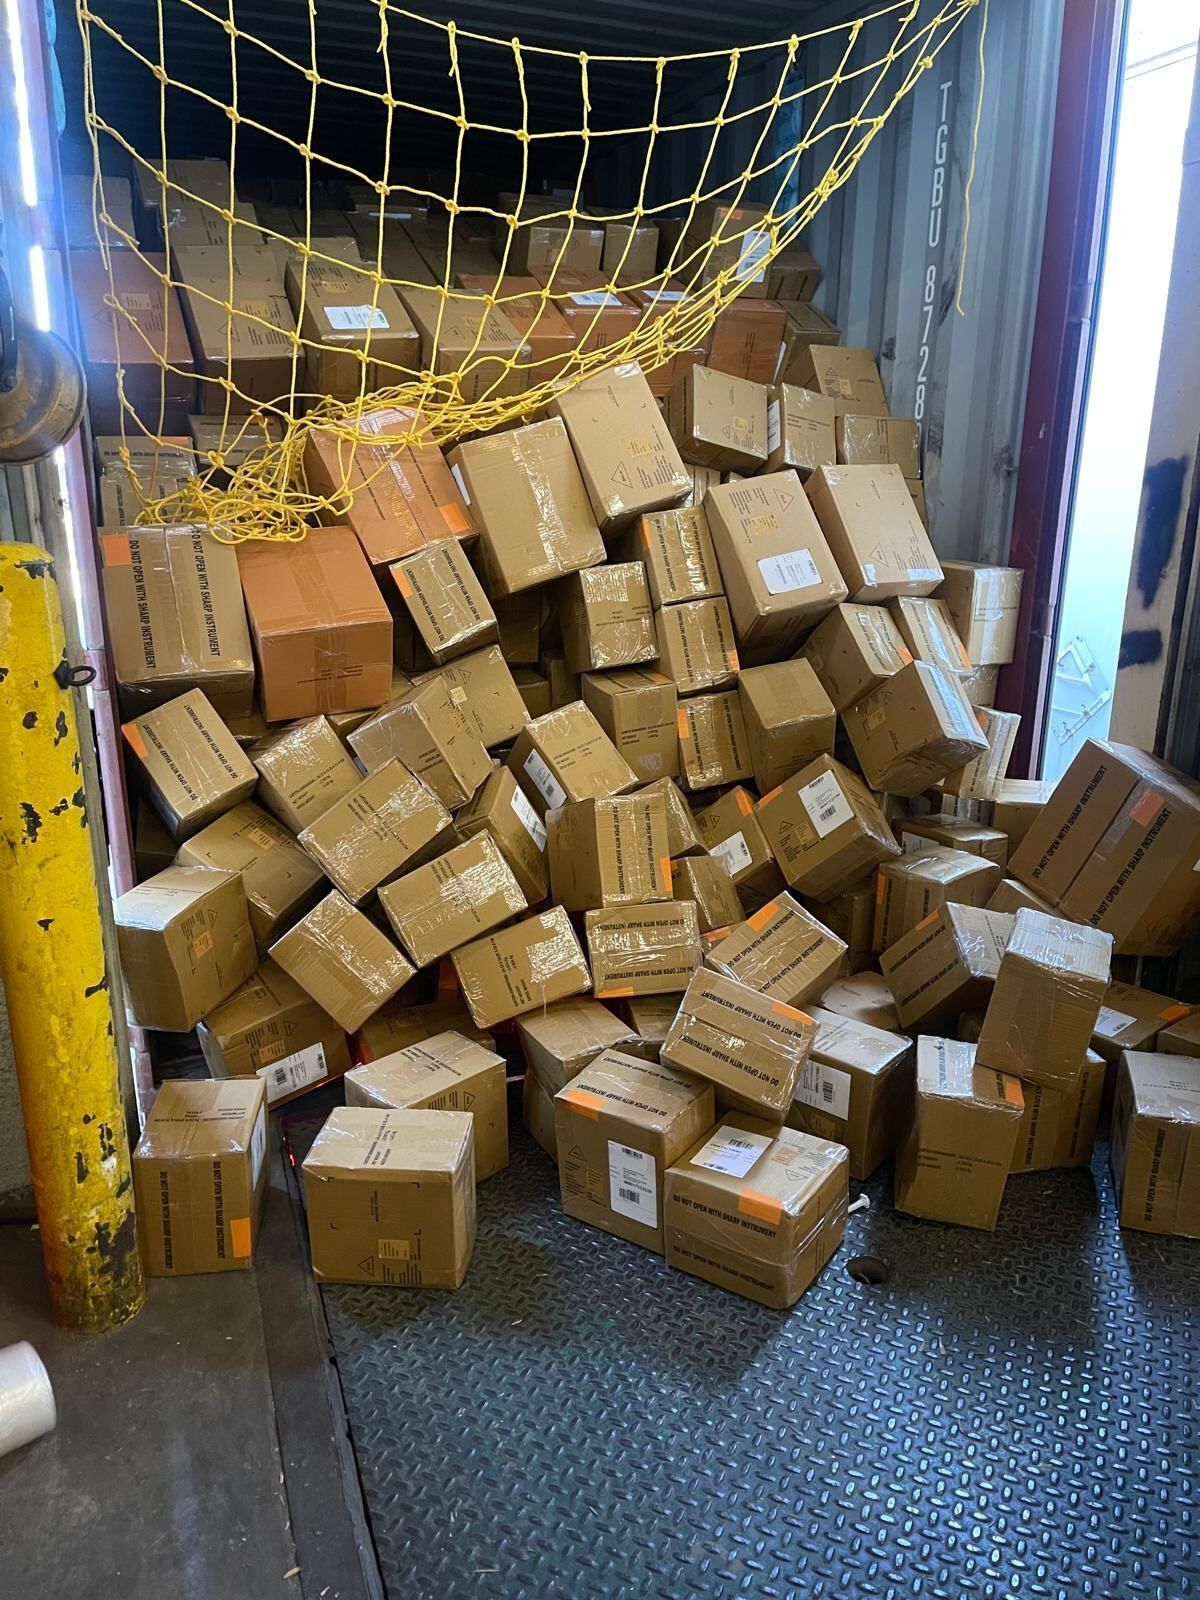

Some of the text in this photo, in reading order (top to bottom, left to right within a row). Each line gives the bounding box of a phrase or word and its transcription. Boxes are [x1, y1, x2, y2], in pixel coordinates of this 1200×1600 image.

[928, 80, 952, 248] TGBU
[193, 540, 203, 554] NOT
[196, 555, 206, 572] OPEN
[198, 574, 208, 589] WITH
[129, 540, 156, 668] DO NOT OPEN WITH SHARP INSTRUMENT
[201, 591, 212, 612] SHARP
[204, 614, 219, 656] INSTRUMENT
[184, 704, 237, 779] DO NOT OPEN WITH SHARP INSTRUMENT
[1031, 765, 1107, 878] DO NOT OPEN WITH SHARP INSTRUMENT
[1091, 809, 1171, 925] DO NOT OPEN WITH SHARP INSTRUMENT
[727, 910, 794, 968] DO NOT OPEN WITH SHARP INSTRUMENT
[762, 981, 771, 990] NOT
[769, 974, 781, 984] OPEN
[779, 966, 791, 976] WITH
[788, 956, 803, 969] SHARP
[800, 936, 825, 958] INSTRUMENT
[604, 971, 633, 979] INSTRUMENT
[701, 990, 734, 1009] INSTRUMENT
[734, 1005, 752, 1016] SHARP
[751, 1013, 766, 1023] WITH
[766, 1019, 781, 1030] OPEN
[781, 1026, 792, 1035] NOT
[711, 1049, 730, 1062] SHARP
[728, 1058, 743, 1069] WITH
[743, 1064, 758, 1076] OPEN
[758, 1072, 770, 1082] NOT
[770, 1077, 779, 1086] DO
[577, 1083, 606, 1095] INSTRUMENT
[605, 1092, 622, 1101] SHARP
[213, 1169, 221, 1180] NOT
[215, 1209, 223, 1225] SHARP
[673, 1194, 775, 1238] DO NOT OPEN WITH SHARP INSTRUMENT
[216, 1227, 224, 1259] INSTRUMENT
[164, 1237, 172, 1268] INSTRUMENT
